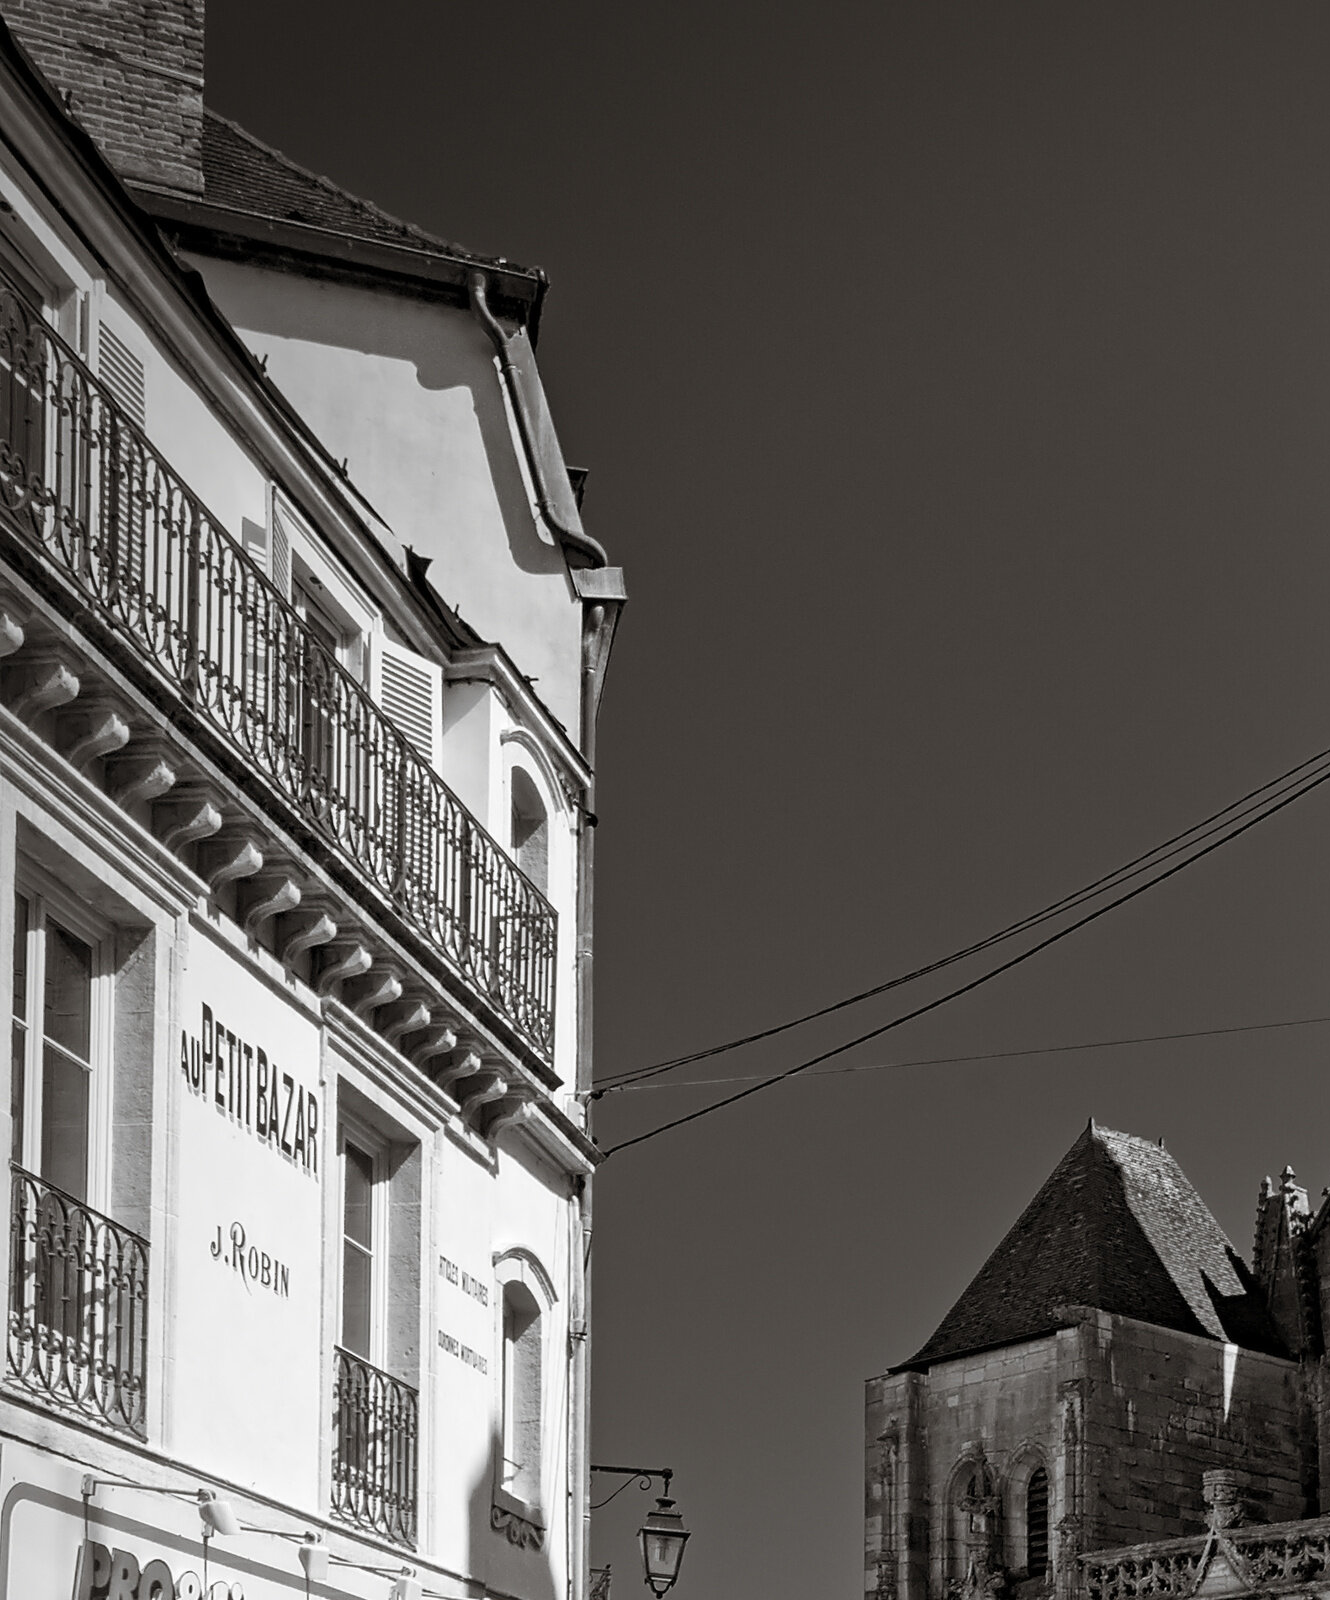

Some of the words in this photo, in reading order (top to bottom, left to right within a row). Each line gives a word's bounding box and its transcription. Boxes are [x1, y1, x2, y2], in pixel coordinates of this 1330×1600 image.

[181, 1030, 200, 1092] AU
[202, 1001, 253, 1130] PETIT
[256, 1045, 319, 1178] BAZAR
